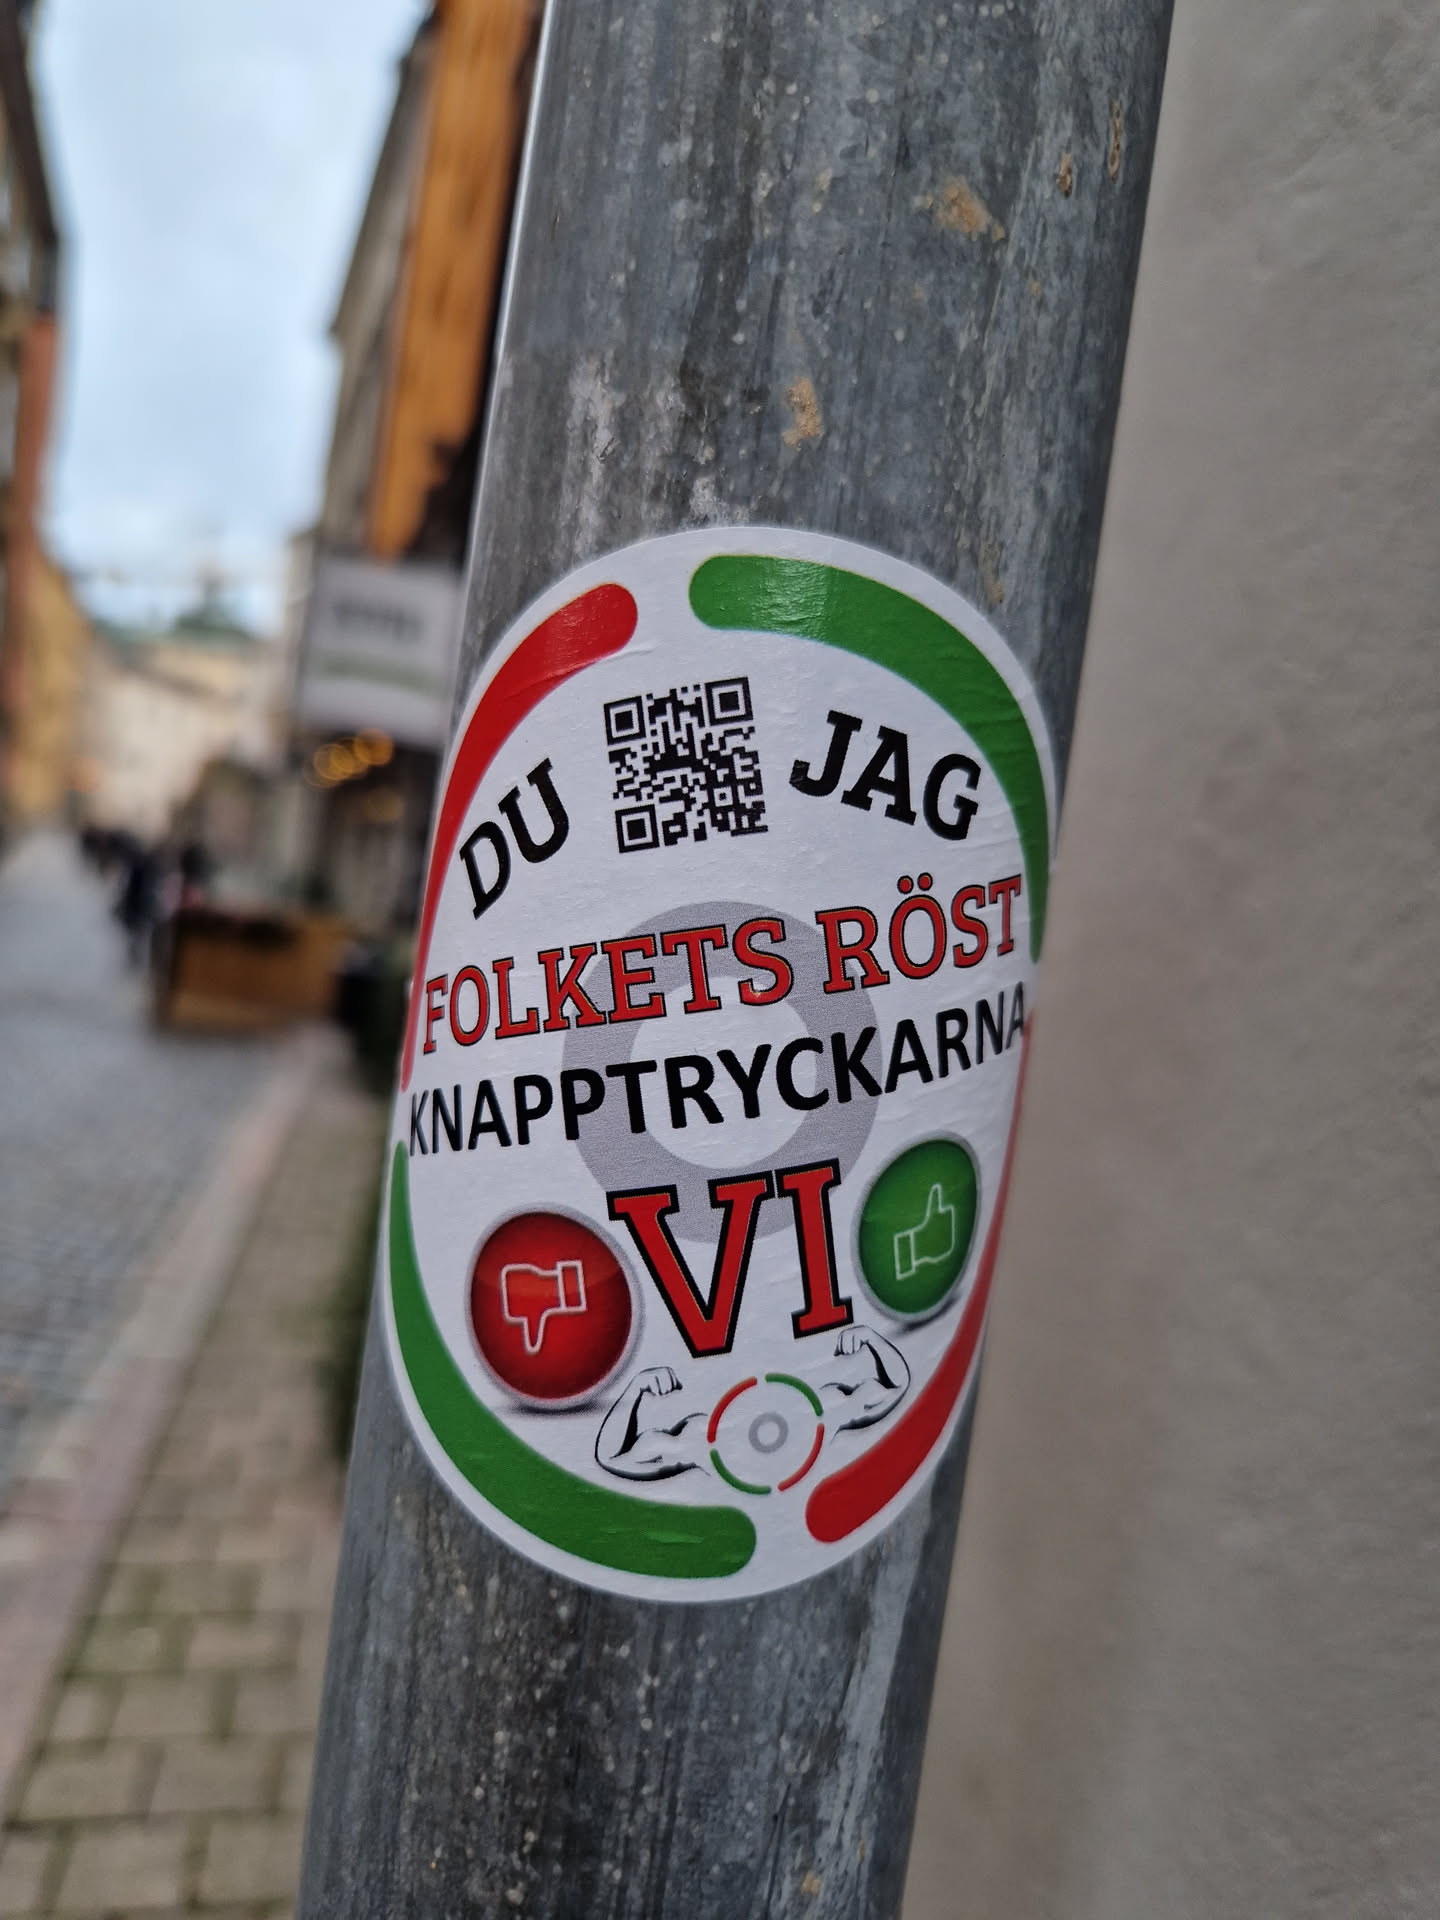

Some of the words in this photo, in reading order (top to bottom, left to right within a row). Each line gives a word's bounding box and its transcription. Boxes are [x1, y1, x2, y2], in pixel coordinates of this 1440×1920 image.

[459, 759, 570, 918] DU
[790, 709, 982, 841] JAG
[422, 917, 794, 1055] FOLKETS
[815, 873, 1022, 995] RÖST
[409, 981, 1025, 1156] KNAPPTRYCKARNA
[607, 1157, 854, 1359] VI
